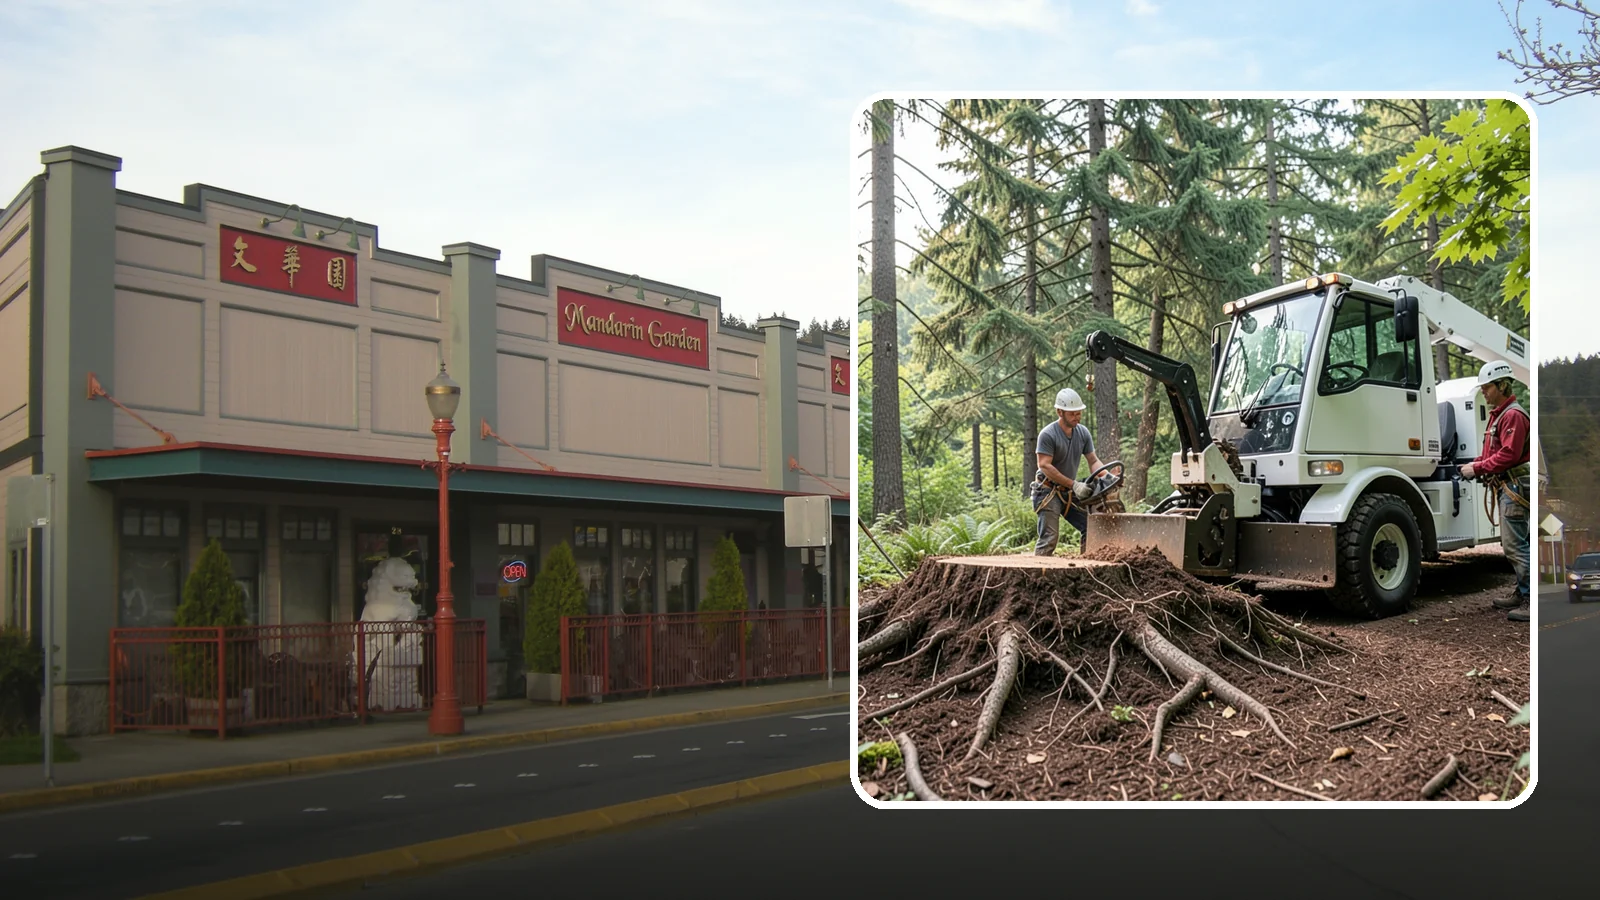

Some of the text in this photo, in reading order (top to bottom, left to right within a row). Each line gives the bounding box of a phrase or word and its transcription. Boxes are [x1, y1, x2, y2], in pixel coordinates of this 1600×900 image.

[230, 235, 346, 291] 文華園
[564, 302, 701, 352] Mandarin Garden
[503, 565, 527, 578] OPEN
